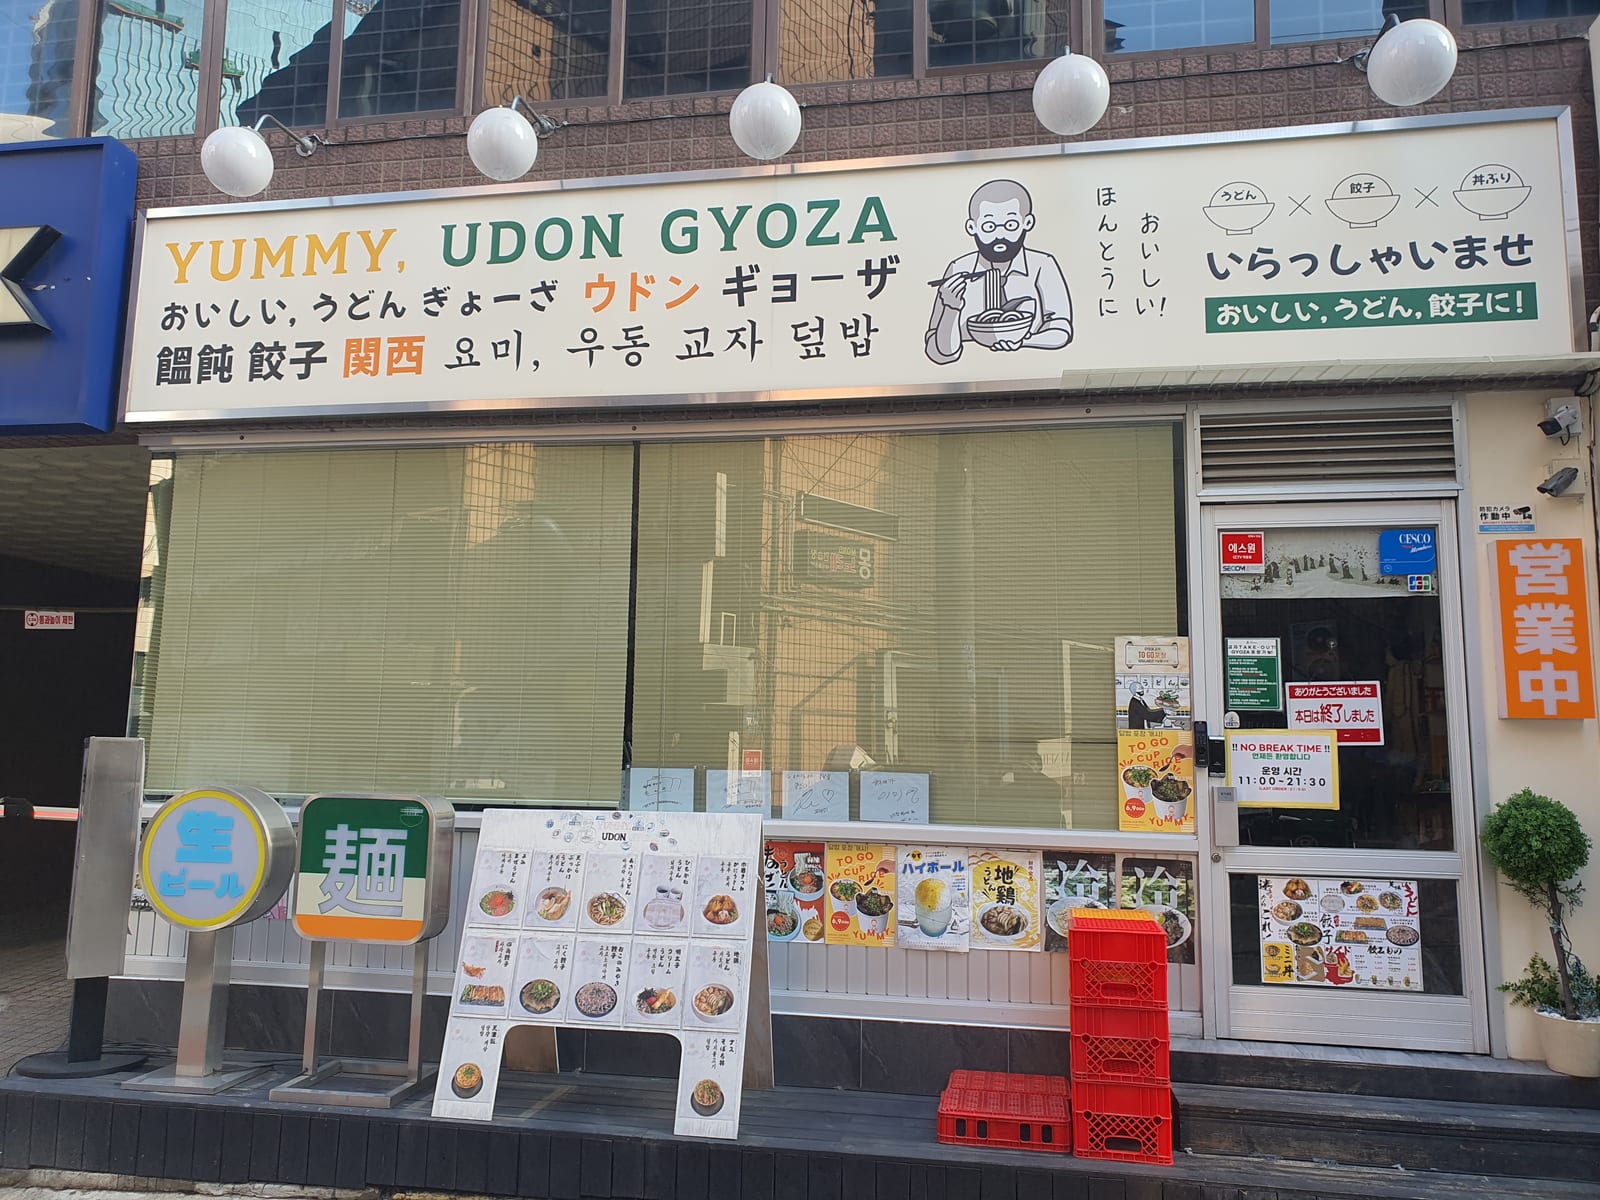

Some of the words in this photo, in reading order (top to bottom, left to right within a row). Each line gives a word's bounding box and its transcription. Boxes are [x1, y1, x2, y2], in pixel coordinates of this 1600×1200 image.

[1349, 181, 1376, 195] 餃子
[1471, 171, 1512, 187] 丼ぶり
[1220, 188, 1258, 202] うどん
[165, 228, 406, 284] YUMMY,
[441, 212, 625, 267] UDON
[660, 196, 898, 256] GYOZA
[1096, 186, 1118, 317] ほんとうに
[1135, 211, 1167, 318] おいしい!
[1206, 232, 1534, 280] いらっしゃいませ
[423, 279, 558, 318] ぎょーざ
[584, 271, 700, 313] ウドン
[722, 254, 900, 308] ギョーザ
[444, 327, 541, 371] 요미,
[565, 324, 651, 368] 우동
[674, 319, 764, 363] 교자
[790, 312, 880, 360] 덮밥
[156, 342, 234, 386] 饂飩
[248, 340, 328, 382] 餃子
[342, 335, 426, 378] 関西
[1479, 512, 1511, 521] 作動中
[1228, 542, 1256, 554] 에스원
[1398, 533, 1431, 544] CESCO
[1508, 542, 1579, 716] 営業中
[1294, 687, 1372, 697] ありがとうございました
[1295, 703, 1375, 724] 本日は終了しました
[1128, 741, 1146, 753] TO
[1150, 737, 1169, 747] GO
[1136, 750, 1160, 762] CUP
[1259, 744, 1294, 752] BREAK
[1297, 744, 1322, 753] TIME
[1261, 766, 1280, 776] 운영
[1283, 767, 1302, 776] 시간
[175, 810, 235, 864] 生
[601, 832, 627, 841] UDON
[317, 823, 409, 918] 麺
[836, 855, 853, 867] TO
[856, 851, 874, 861] GO
[843, 864, 866, 876] CUP
[158, 867, 245, 899] ビール
[625, 857, 634, 896] あさりうどん
[983, 867, 996, 892] うどん
[993, 865, 1016, 906] 地鶏
[1403, 881, 1418, 917] うどん
[1319, 913, 1335, 945] 餃子
[657, 947, 665, 968] うどん
[1282, 944, 1295, 978] ミニ丼
